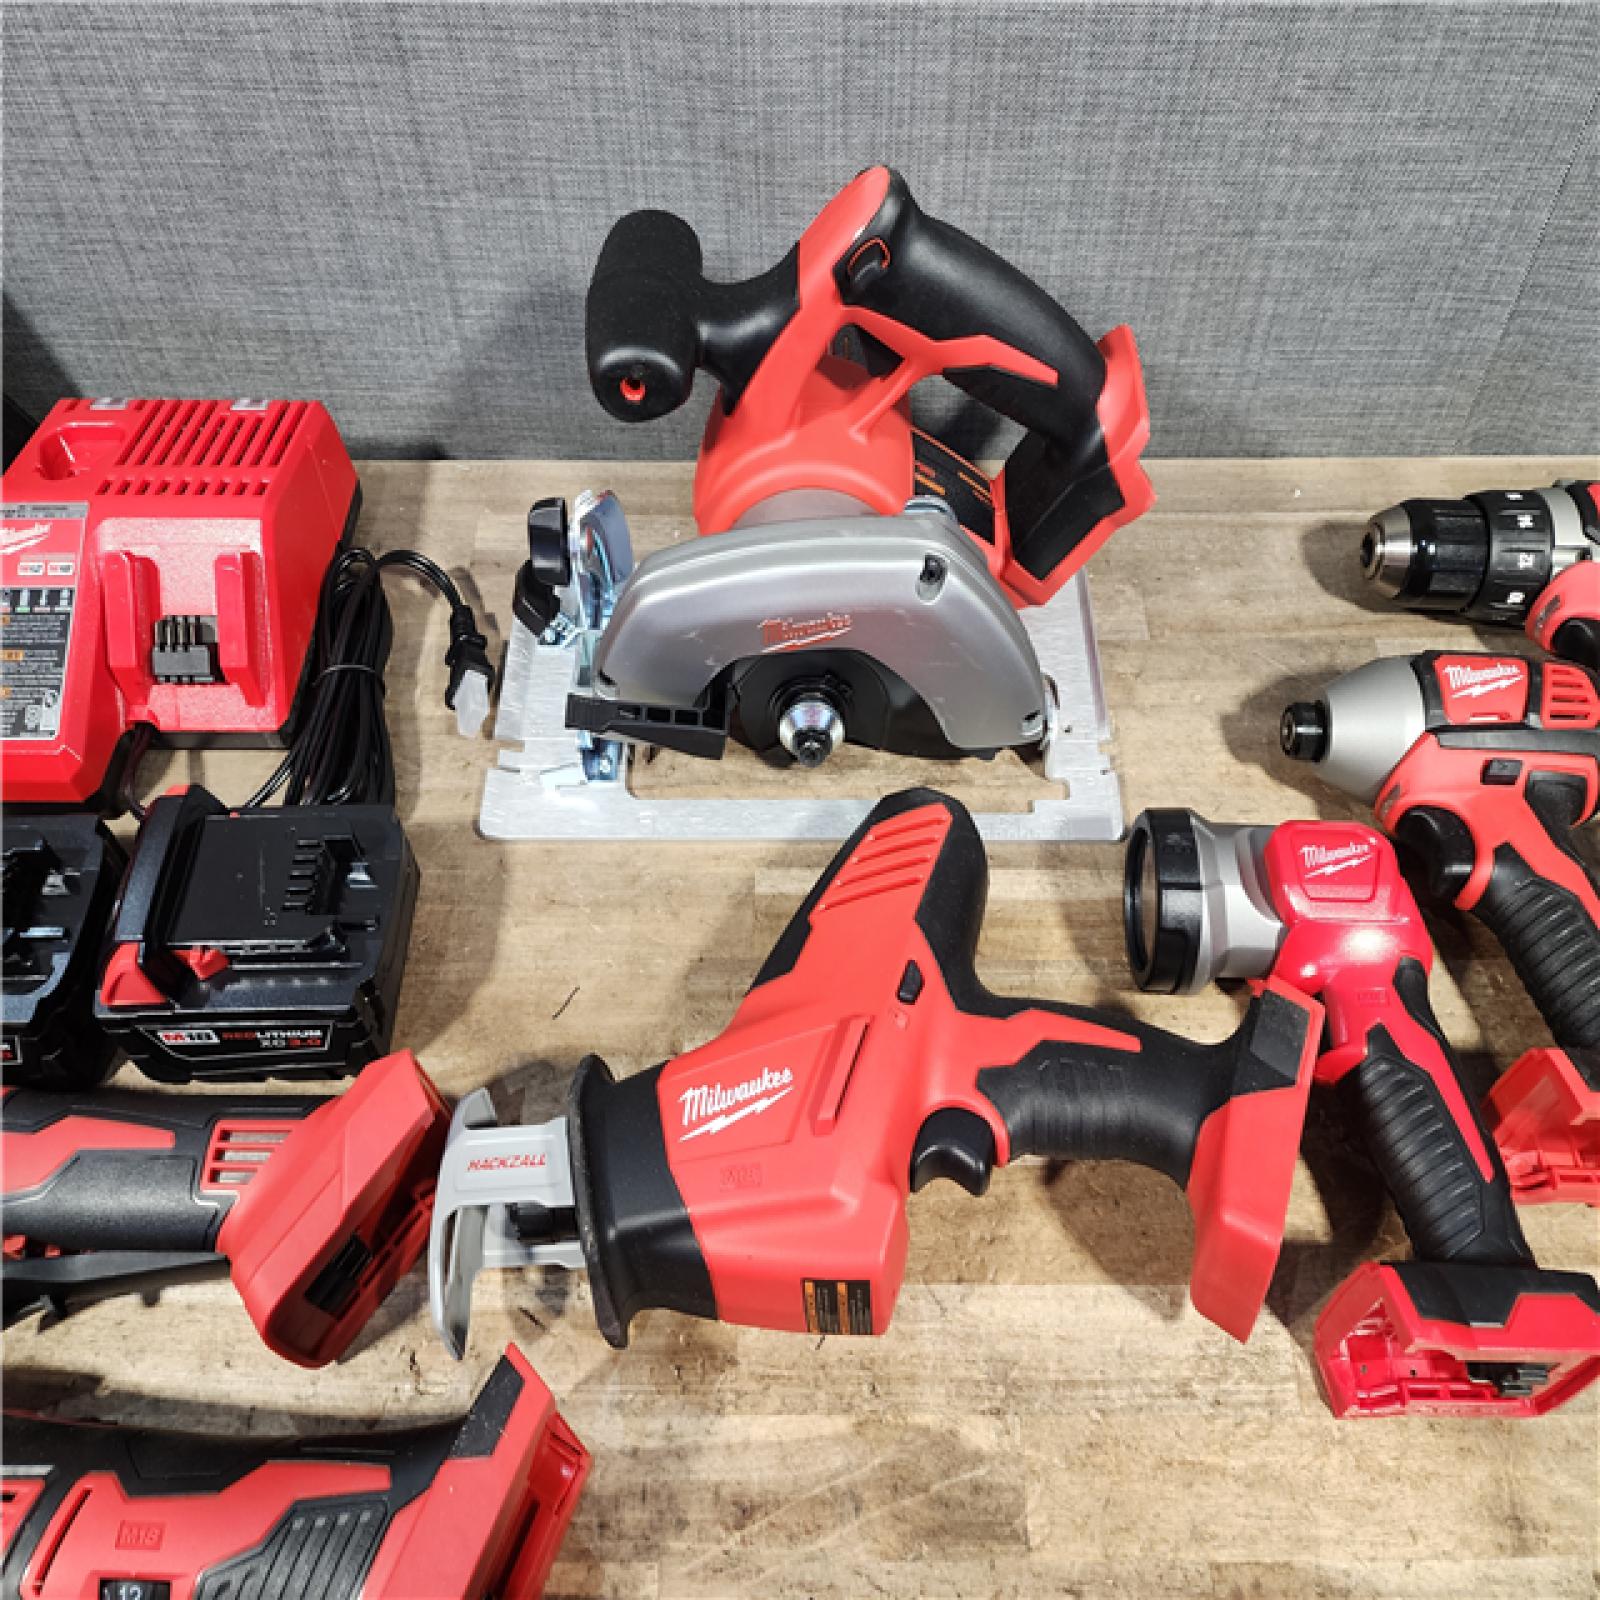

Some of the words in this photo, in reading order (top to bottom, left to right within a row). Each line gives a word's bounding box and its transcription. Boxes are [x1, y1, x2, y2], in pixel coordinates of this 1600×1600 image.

[757, 612, 852, 647] Milwaukee
[1443, 662, 1521, 690] Milwaukee
[1297, 841, 1369, 869] Milwaukee
[678, 1066, 793, 1127] Milwaukee
[467, 1153, 546, 1172] HACKZALL
